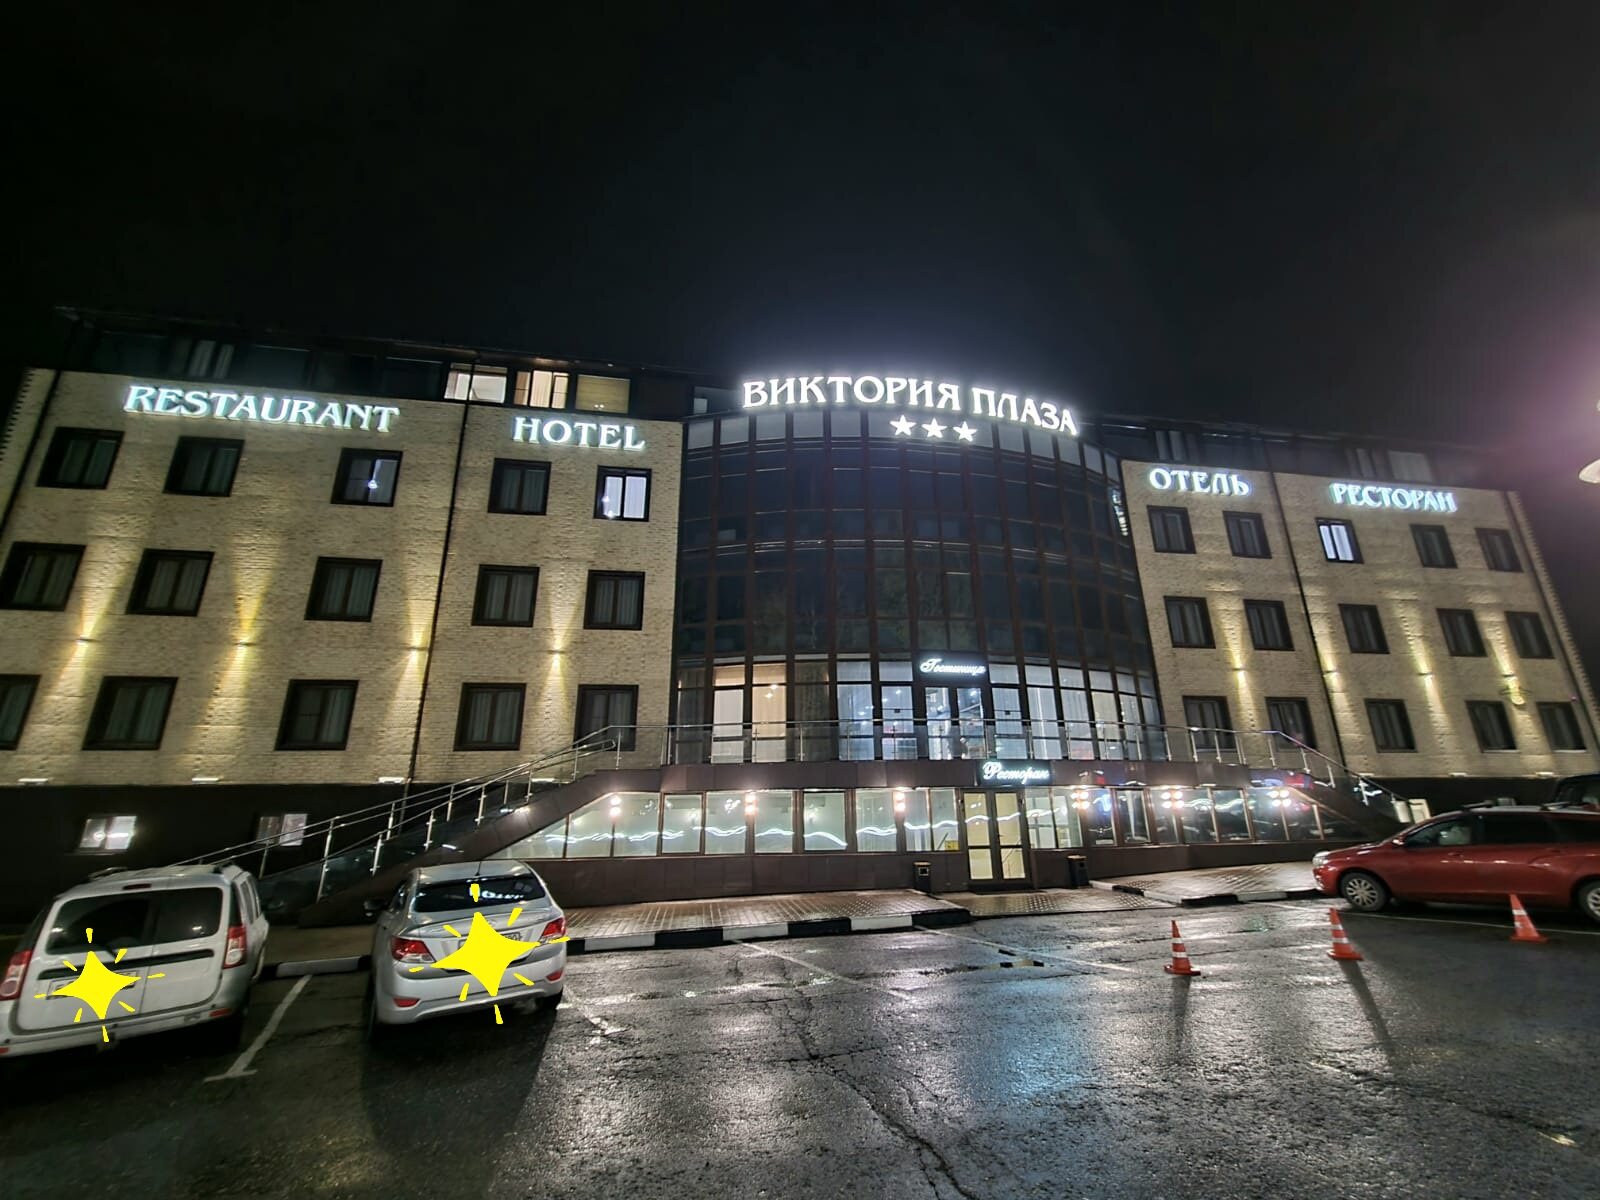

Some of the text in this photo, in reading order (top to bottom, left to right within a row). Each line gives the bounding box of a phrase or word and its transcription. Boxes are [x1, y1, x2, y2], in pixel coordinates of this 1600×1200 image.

[123, 385, 400, 433] RESTAURANT
[742, 375, 1080, 437] ВИКТОРИЯ ПЛАЗА
[513, 416, 646, 452] HOTEL
[1148, 467, 1251, 497] ОТЕЛЬ
[1329, 482, 1458, 512] РЕСТОРАН
[919, 658, 986, 676] Гостиница
[982, 761, 1050, 785] Ресторан
